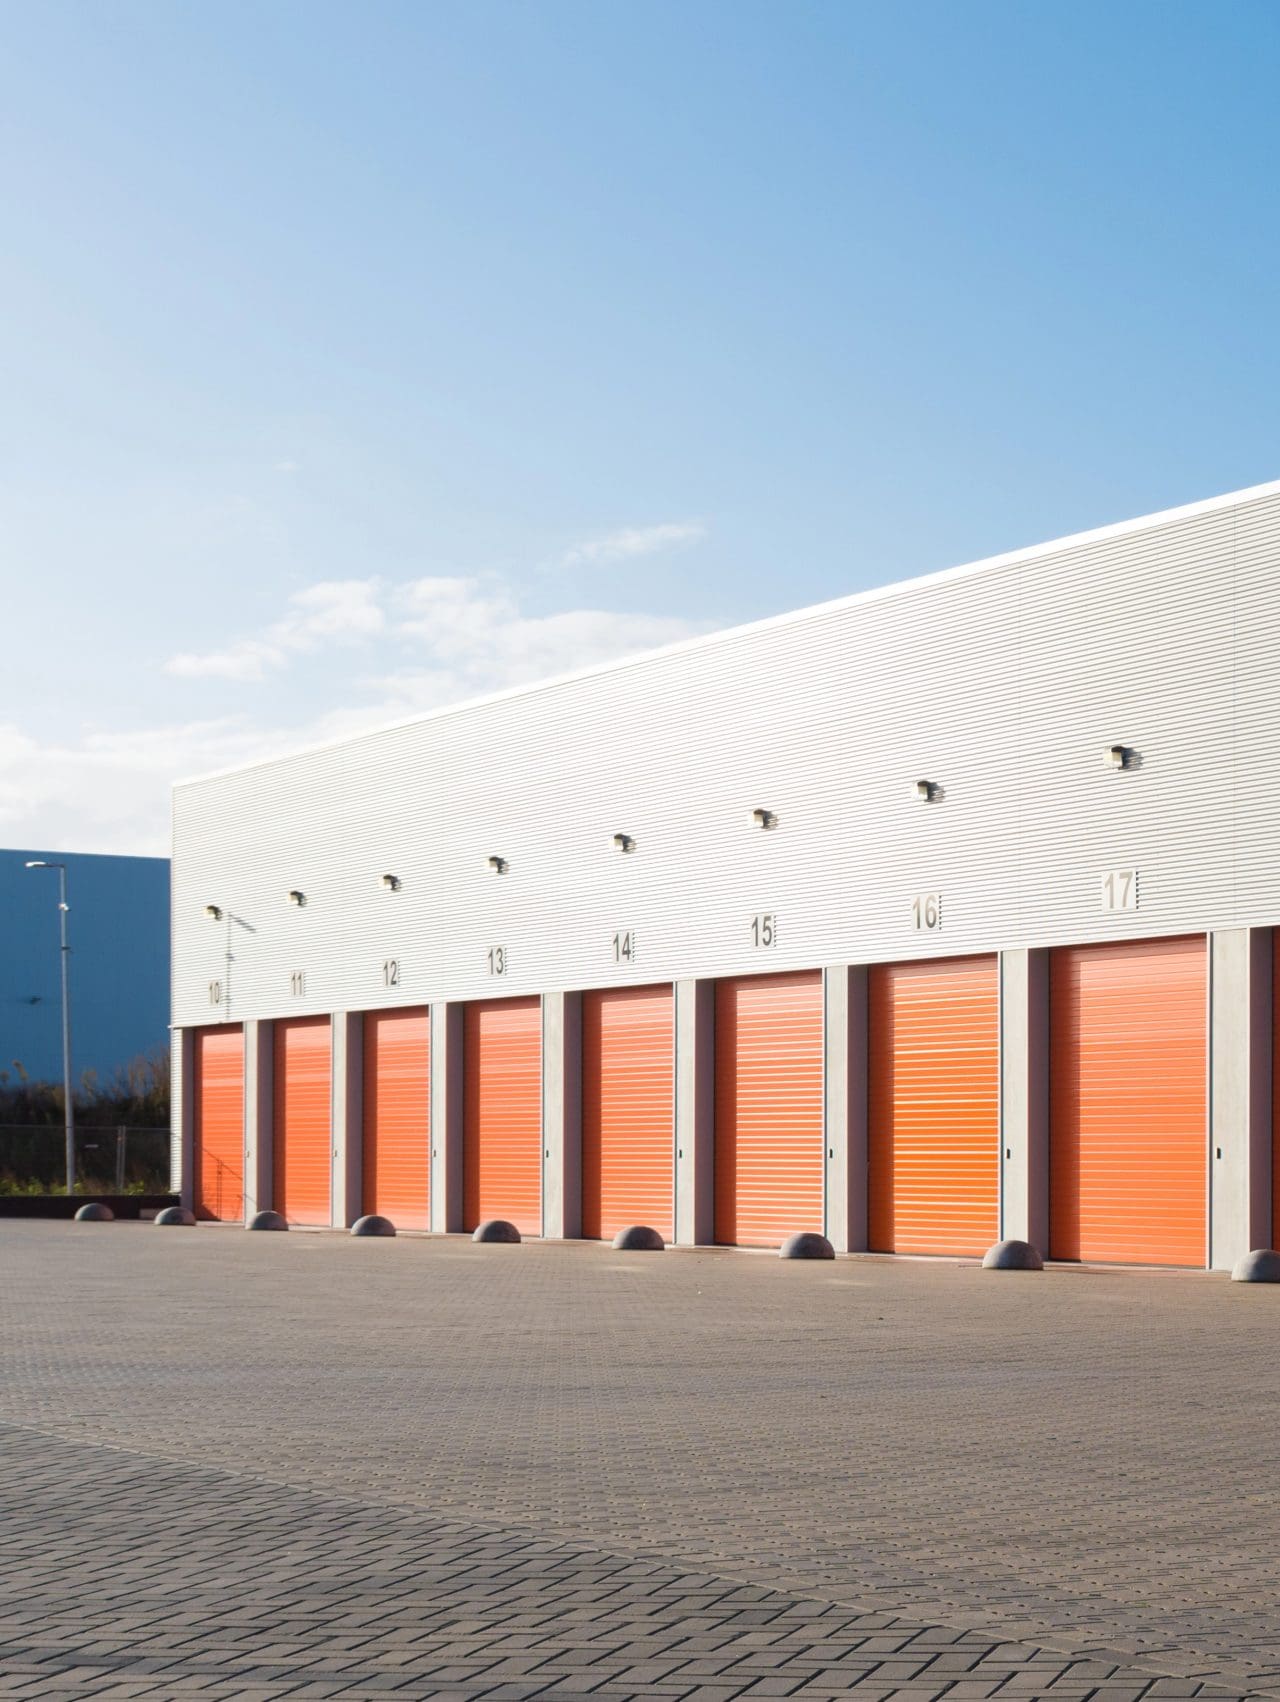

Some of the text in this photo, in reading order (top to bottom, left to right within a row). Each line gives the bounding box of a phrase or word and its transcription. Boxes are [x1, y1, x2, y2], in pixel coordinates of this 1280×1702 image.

[1104, 872, 1133, 909] 17
[912, 894, 937, 929] 16
[751, 916, 772, 946] 15
[613, 932, 631, 961] 14
[384, 961, 397, 985] 12
[488, 948, 503, 974] 13
[209, 982, 220, 1004] 10
[292, 972, 303, 995] 11
